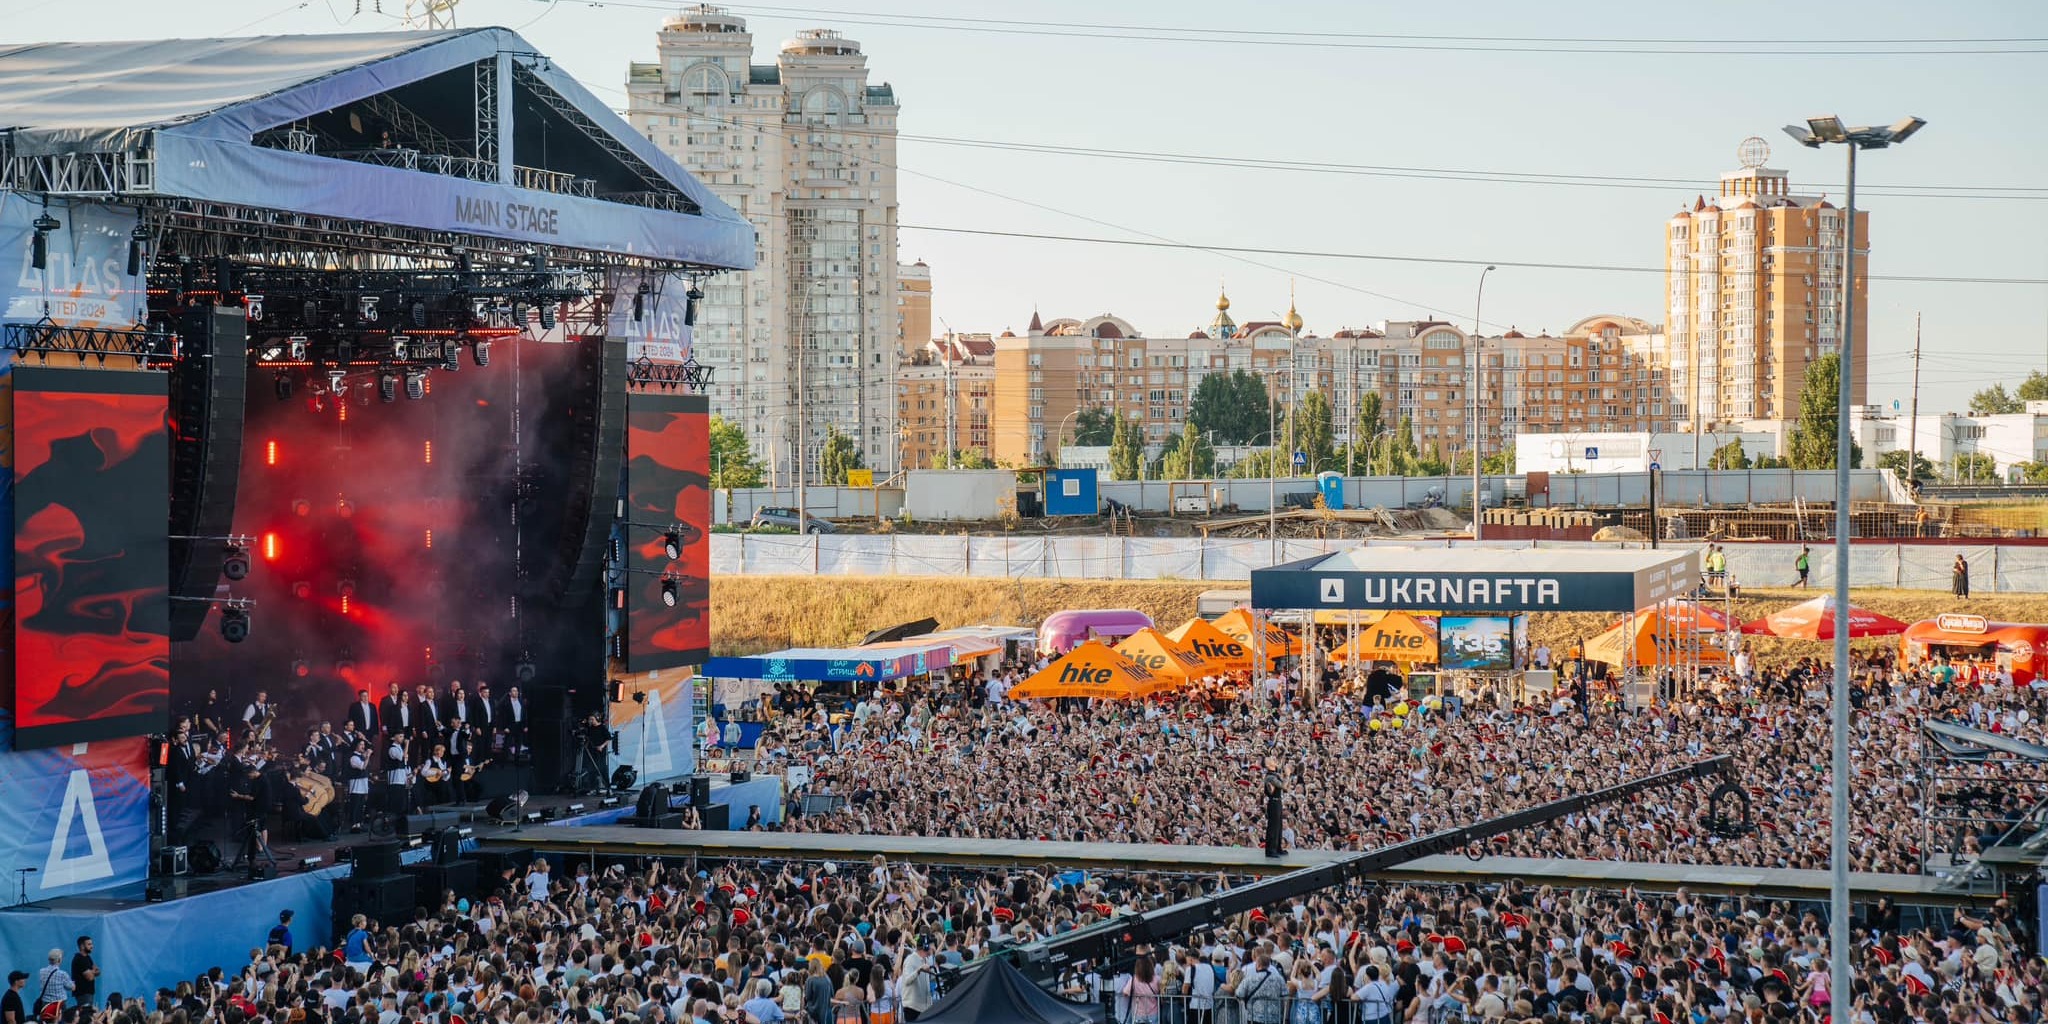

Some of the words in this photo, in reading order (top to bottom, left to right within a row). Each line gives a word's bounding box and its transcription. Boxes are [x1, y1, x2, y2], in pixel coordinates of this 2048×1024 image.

[455, 195, 500, 227] MAIN
[506, 203, 558, 235] STAGE
[80, 302, 105, 318] 2024
[1365, 578, 1559, 604] UKRNAFTA
[1192, 638, 1243, 657] hike
[1374, 630, 1423, 649] hike
[1059, 662, 1112, 684] hike
